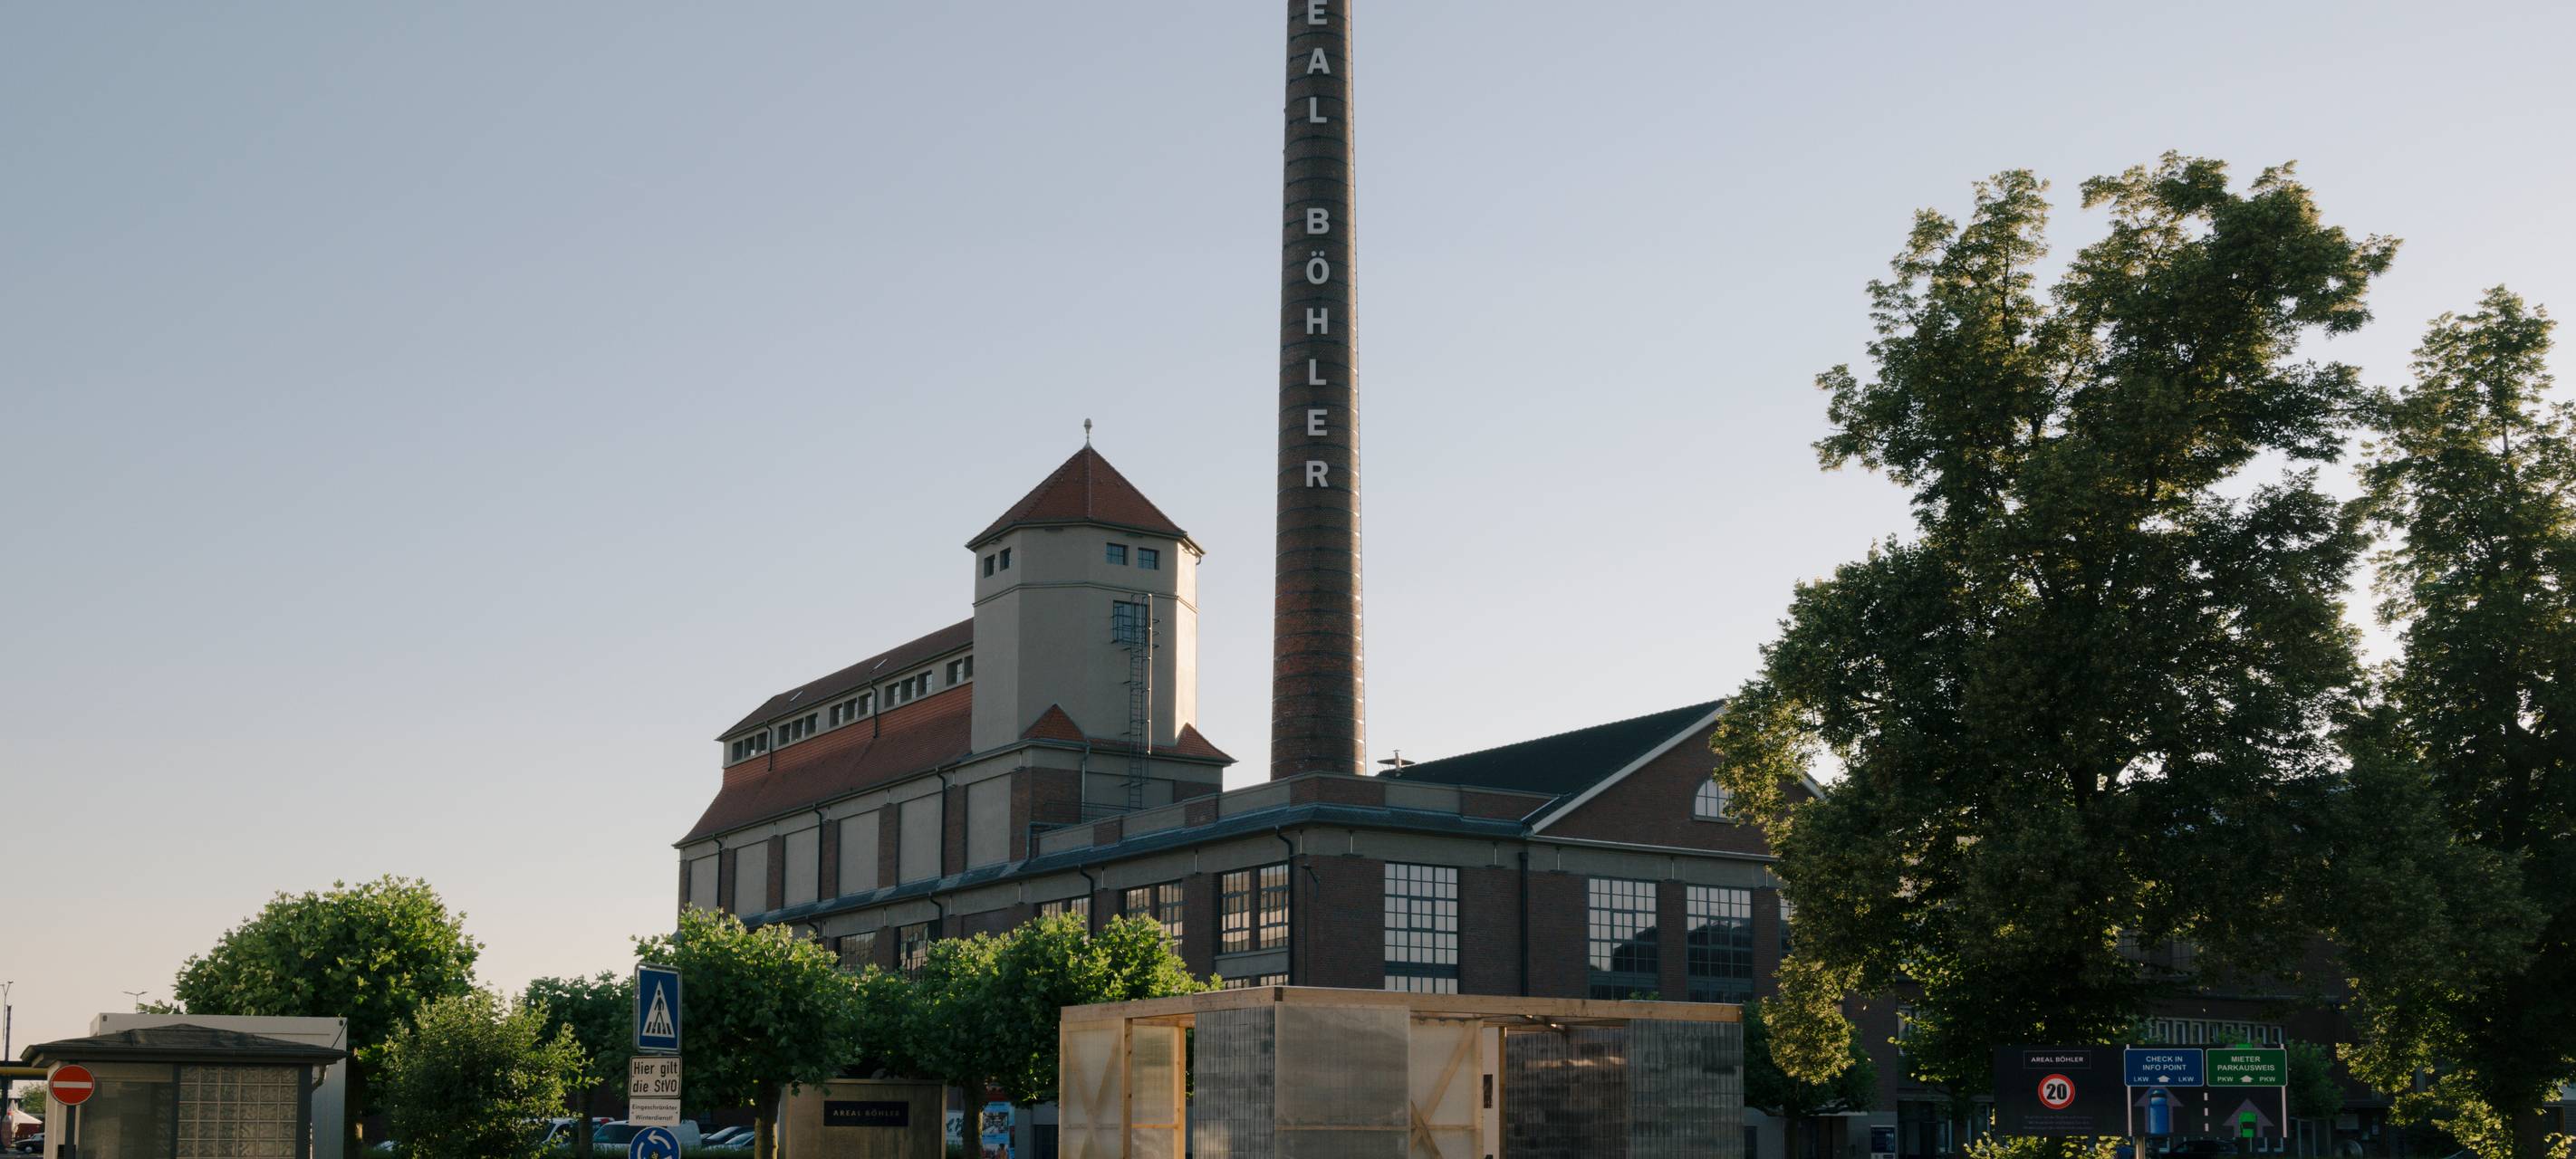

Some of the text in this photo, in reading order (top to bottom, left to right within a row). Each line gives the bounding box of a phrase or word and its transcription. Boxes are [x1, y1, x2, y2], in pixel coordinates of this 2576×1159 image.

[1305, 207, 1330, 487] BÖHLER
[633, 1061, 678, 1077] Hier gilt
[632, 1079, 678, 1093] die StVO
[2046, 1083, 2067, 1100] 20
